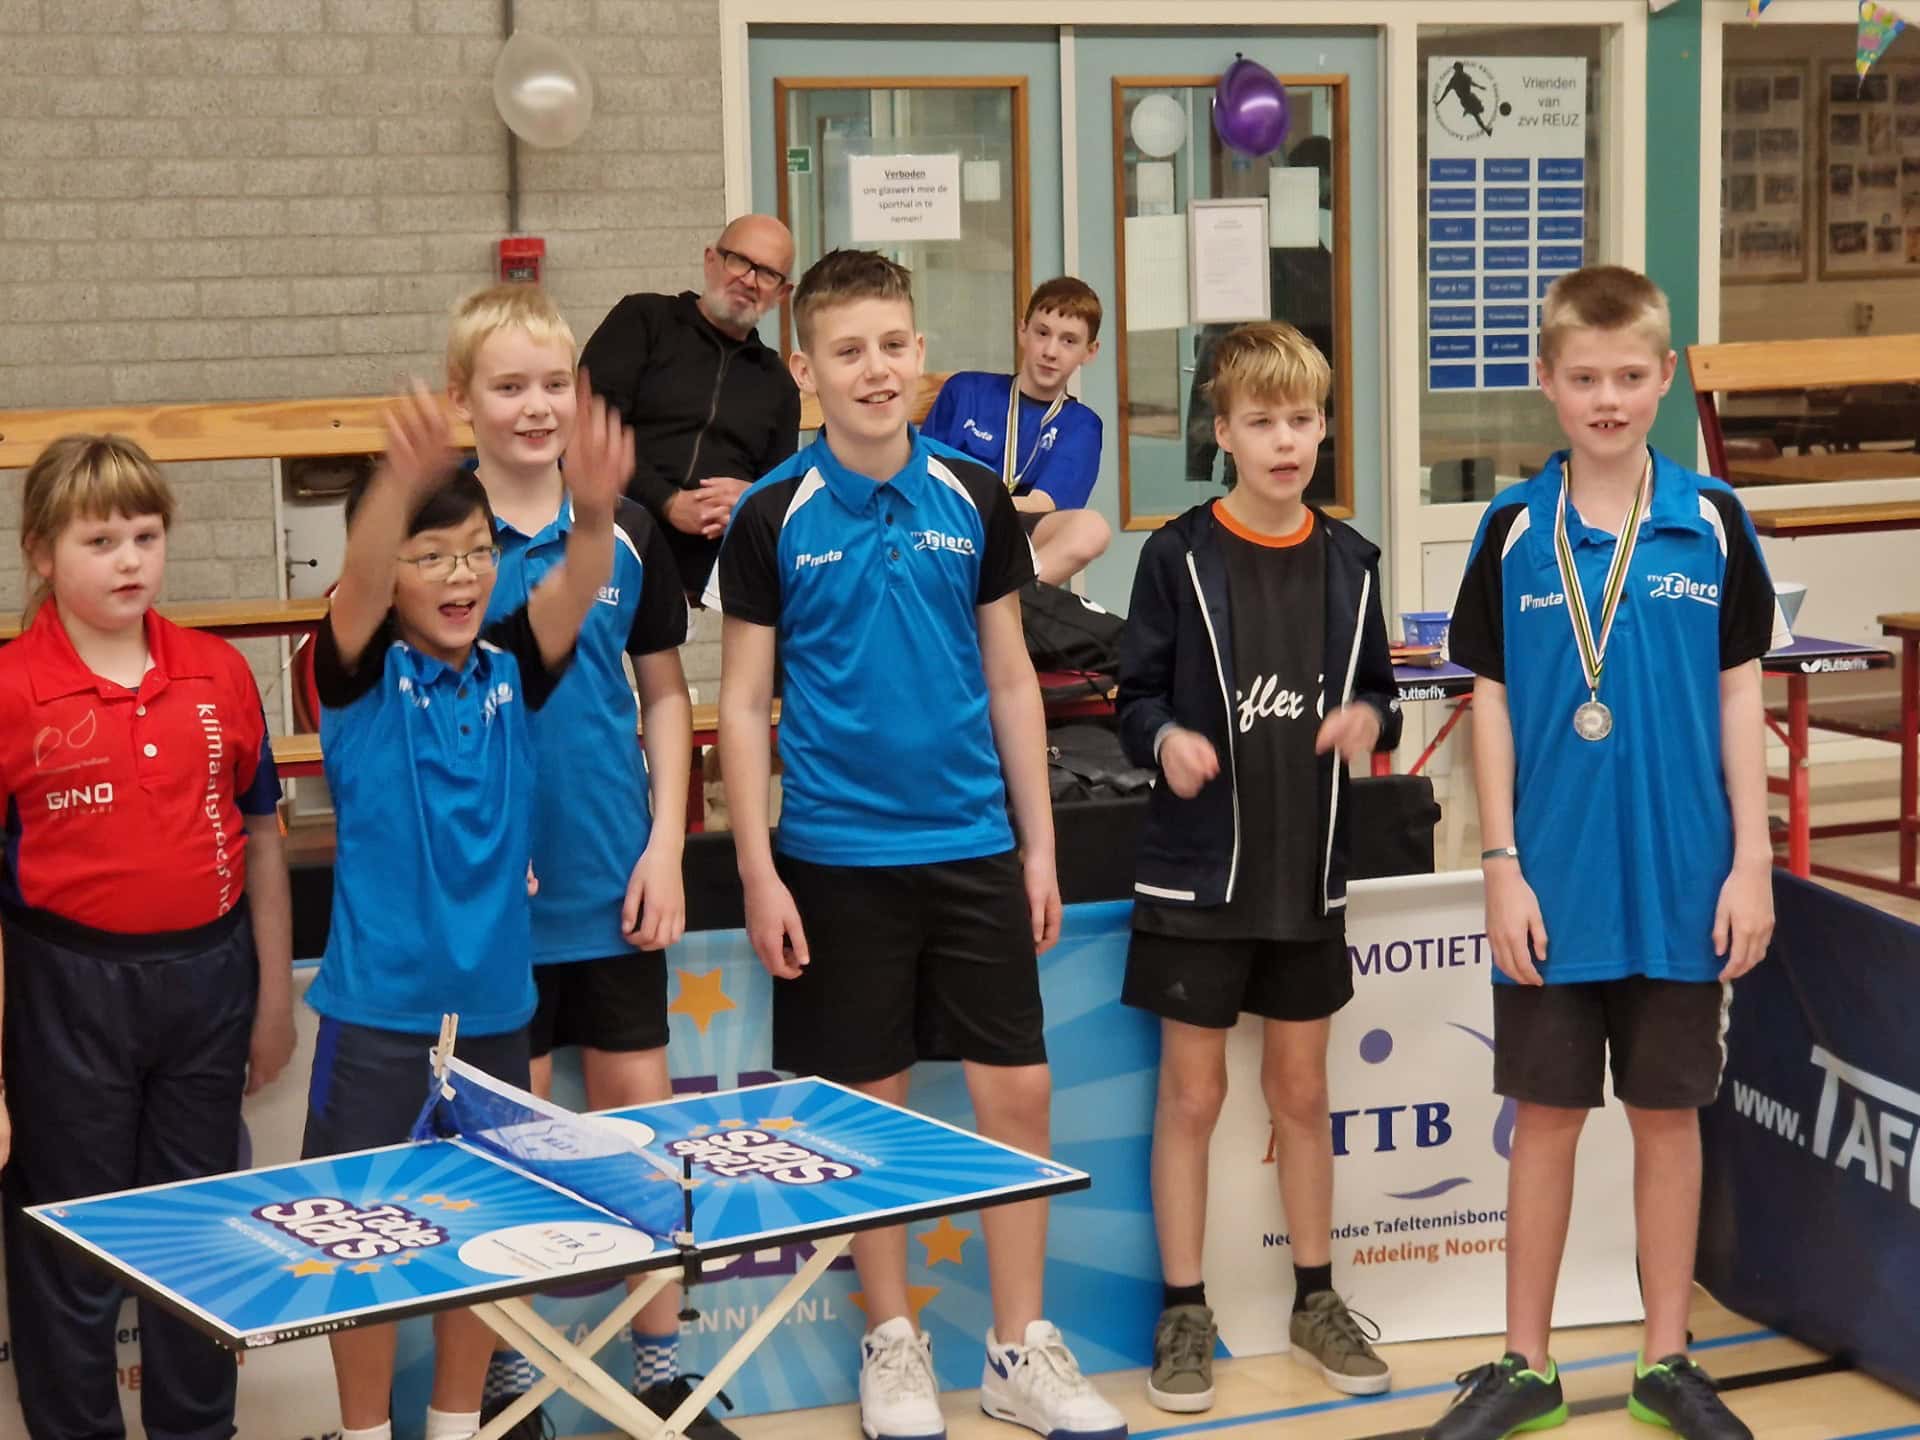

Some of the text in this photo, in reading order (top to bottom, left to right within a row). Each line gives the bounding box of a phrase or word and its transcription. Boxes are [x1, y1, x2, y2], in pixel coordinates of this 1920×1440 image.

[1522, 76, 1577, 89] Vrienden
[1537, 98, 1560, 108] van
[1542, 112, 1580, 127] REUZ
[884, 169, 926, 180] Verboden
[879, 184, 915, 196] glaswerk
[879, 200, 913, 211] sporthal
[1663, 575, 1718, 598] Talero
[1236, 673, 1305, 733] flex
[46, 782, 113, 811] GINO
[1352, 1240, 1440, 1267] Afdeling
